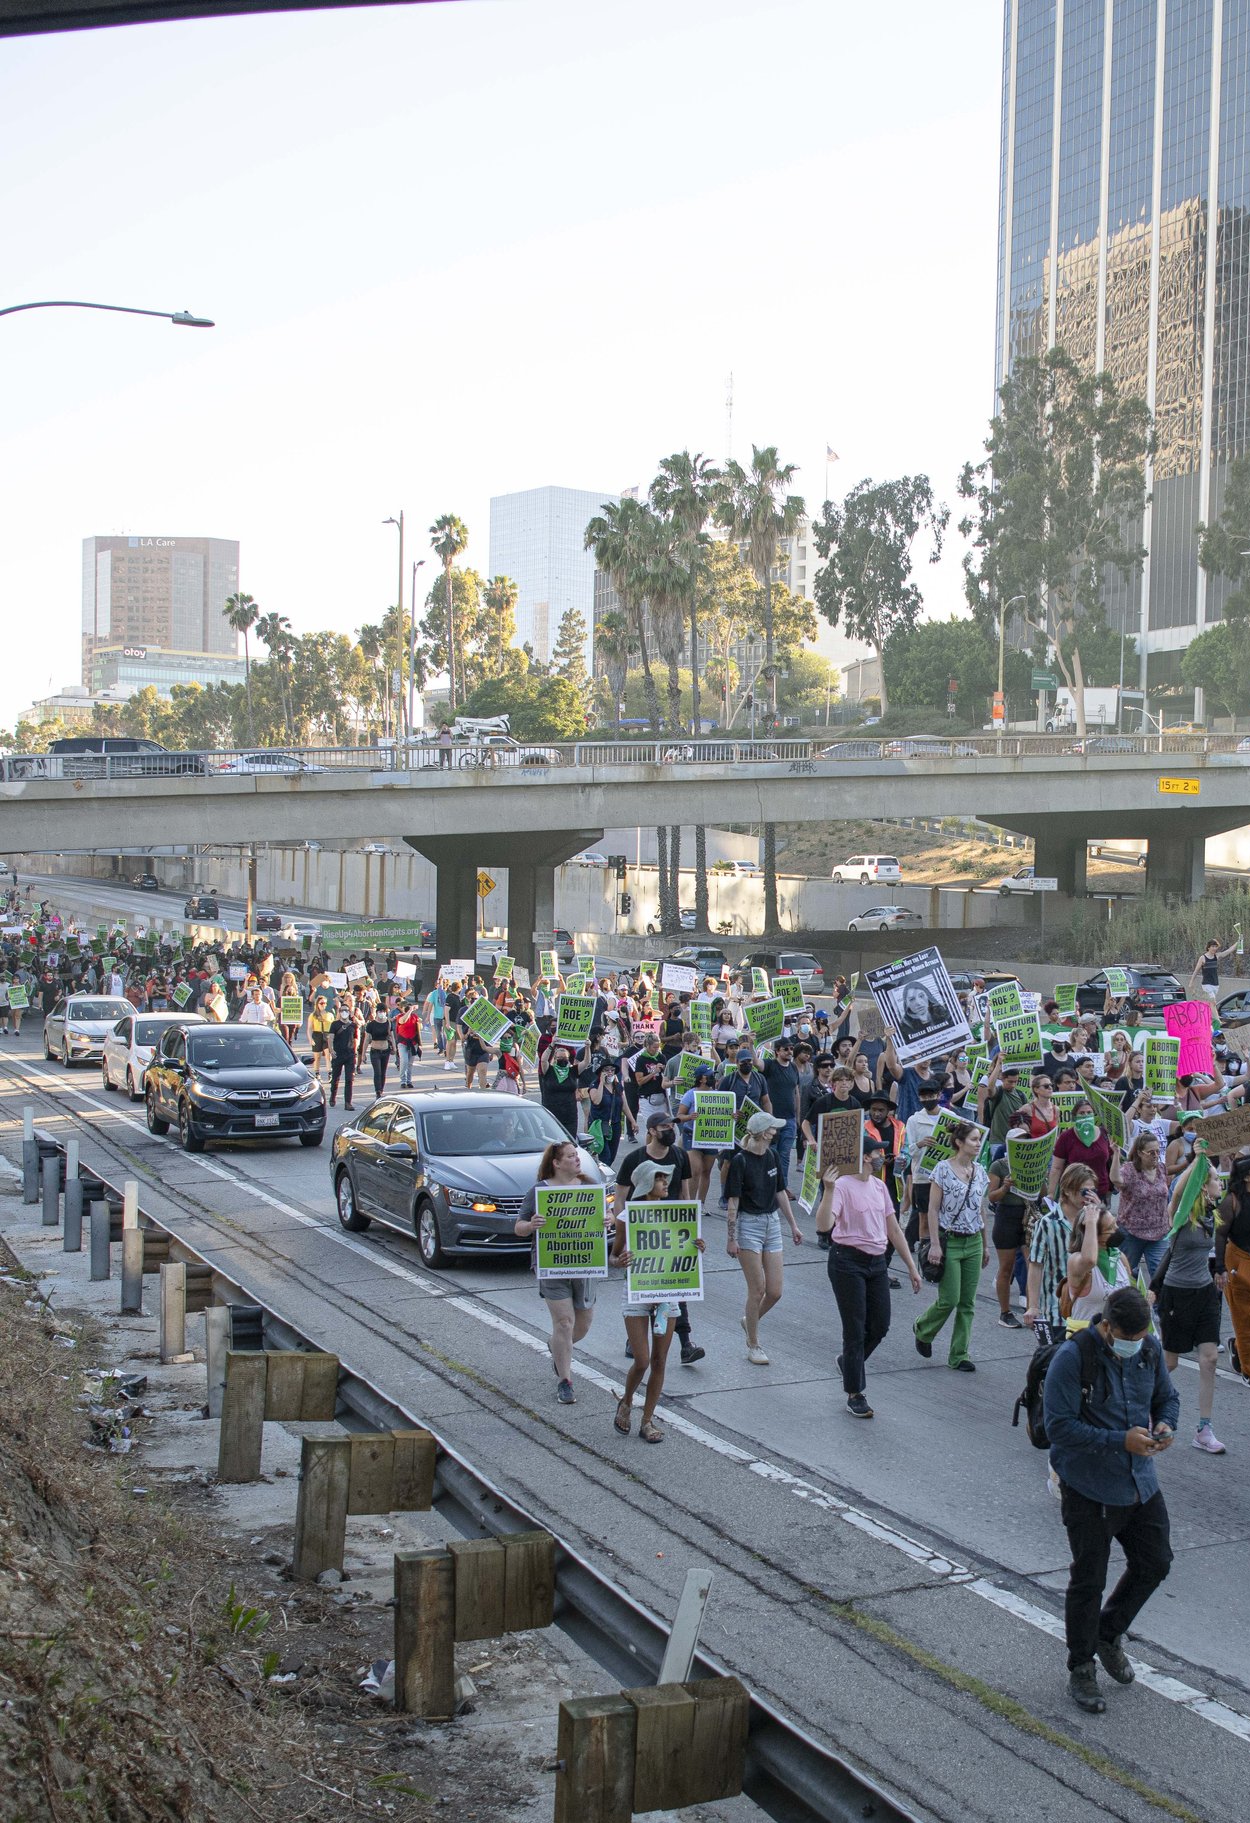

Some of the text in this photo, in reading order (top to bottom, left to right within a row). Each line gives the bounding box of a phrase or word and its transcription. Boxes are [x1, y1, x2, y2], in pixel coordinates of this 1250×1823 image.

[157, 538, 176, 546] Care
[124, 647, 147, 658] otoy
[1161, 780, 1171, 790] 15
[1183, 782, 1190, 792] 2
[323, 928, 419, 940] RiseUp4AbortionRights.org
[776, 988, 790, 996] ROE
[560, 998, 594, 1008] OVERTURN
[992, 993, 1016, 1006] ROE ?
[751, 1002, 778, 1015] STOP the
[992, 1008, 1006, 1016] HELL
[562, 1009, 590, 1020] ROE ?
[752, 1010, 780, 1022] Supreme
[1166, 1002, 1212, 1028] ABORT
[558, 1022, 576, 1032] HELL
[998, 1016, 1036, 1030] OVERTURN
[1003, 1028, 1034, 1042] ROE ?
[1024, 1042, 1040, 1052] NO!
[687, 1056, 700, 1065] STOP
[1146, 1055, 1156, 1064] ON
[1148, 1070, 1153, 1078] &
[700, 1096, 730, 1104] ABORTION
[698, 1106, 733, 1114] ON DEMAND
[705, 1119, 731, 1128] WITHOUT
[824, 1114, 858, 1130] UTERUS
[700, 1130, 728, 1138] APOLOGY
[822, 1146, 854, 1158] WHITE
[1016, 1142, 1038, 1151] STOP
[1023, 1158, 1046, 1169] Court
[546, 1192, 594, 1204] STOP the
[546, 1206, 596, 1218] Supreme
[628, 1208, 697, 1224] OVERTURN
[556, 1218, 586, 1229] Court
[539, 1231, 604, 1240] from taking away
[636, 1228, 690, 1250] ROE ?
[546, 1240, 594, 1250] Abortion
[553, 1253, 592, 1265] Rights!
[630, 1255, 698, 1274] HELL NO!
